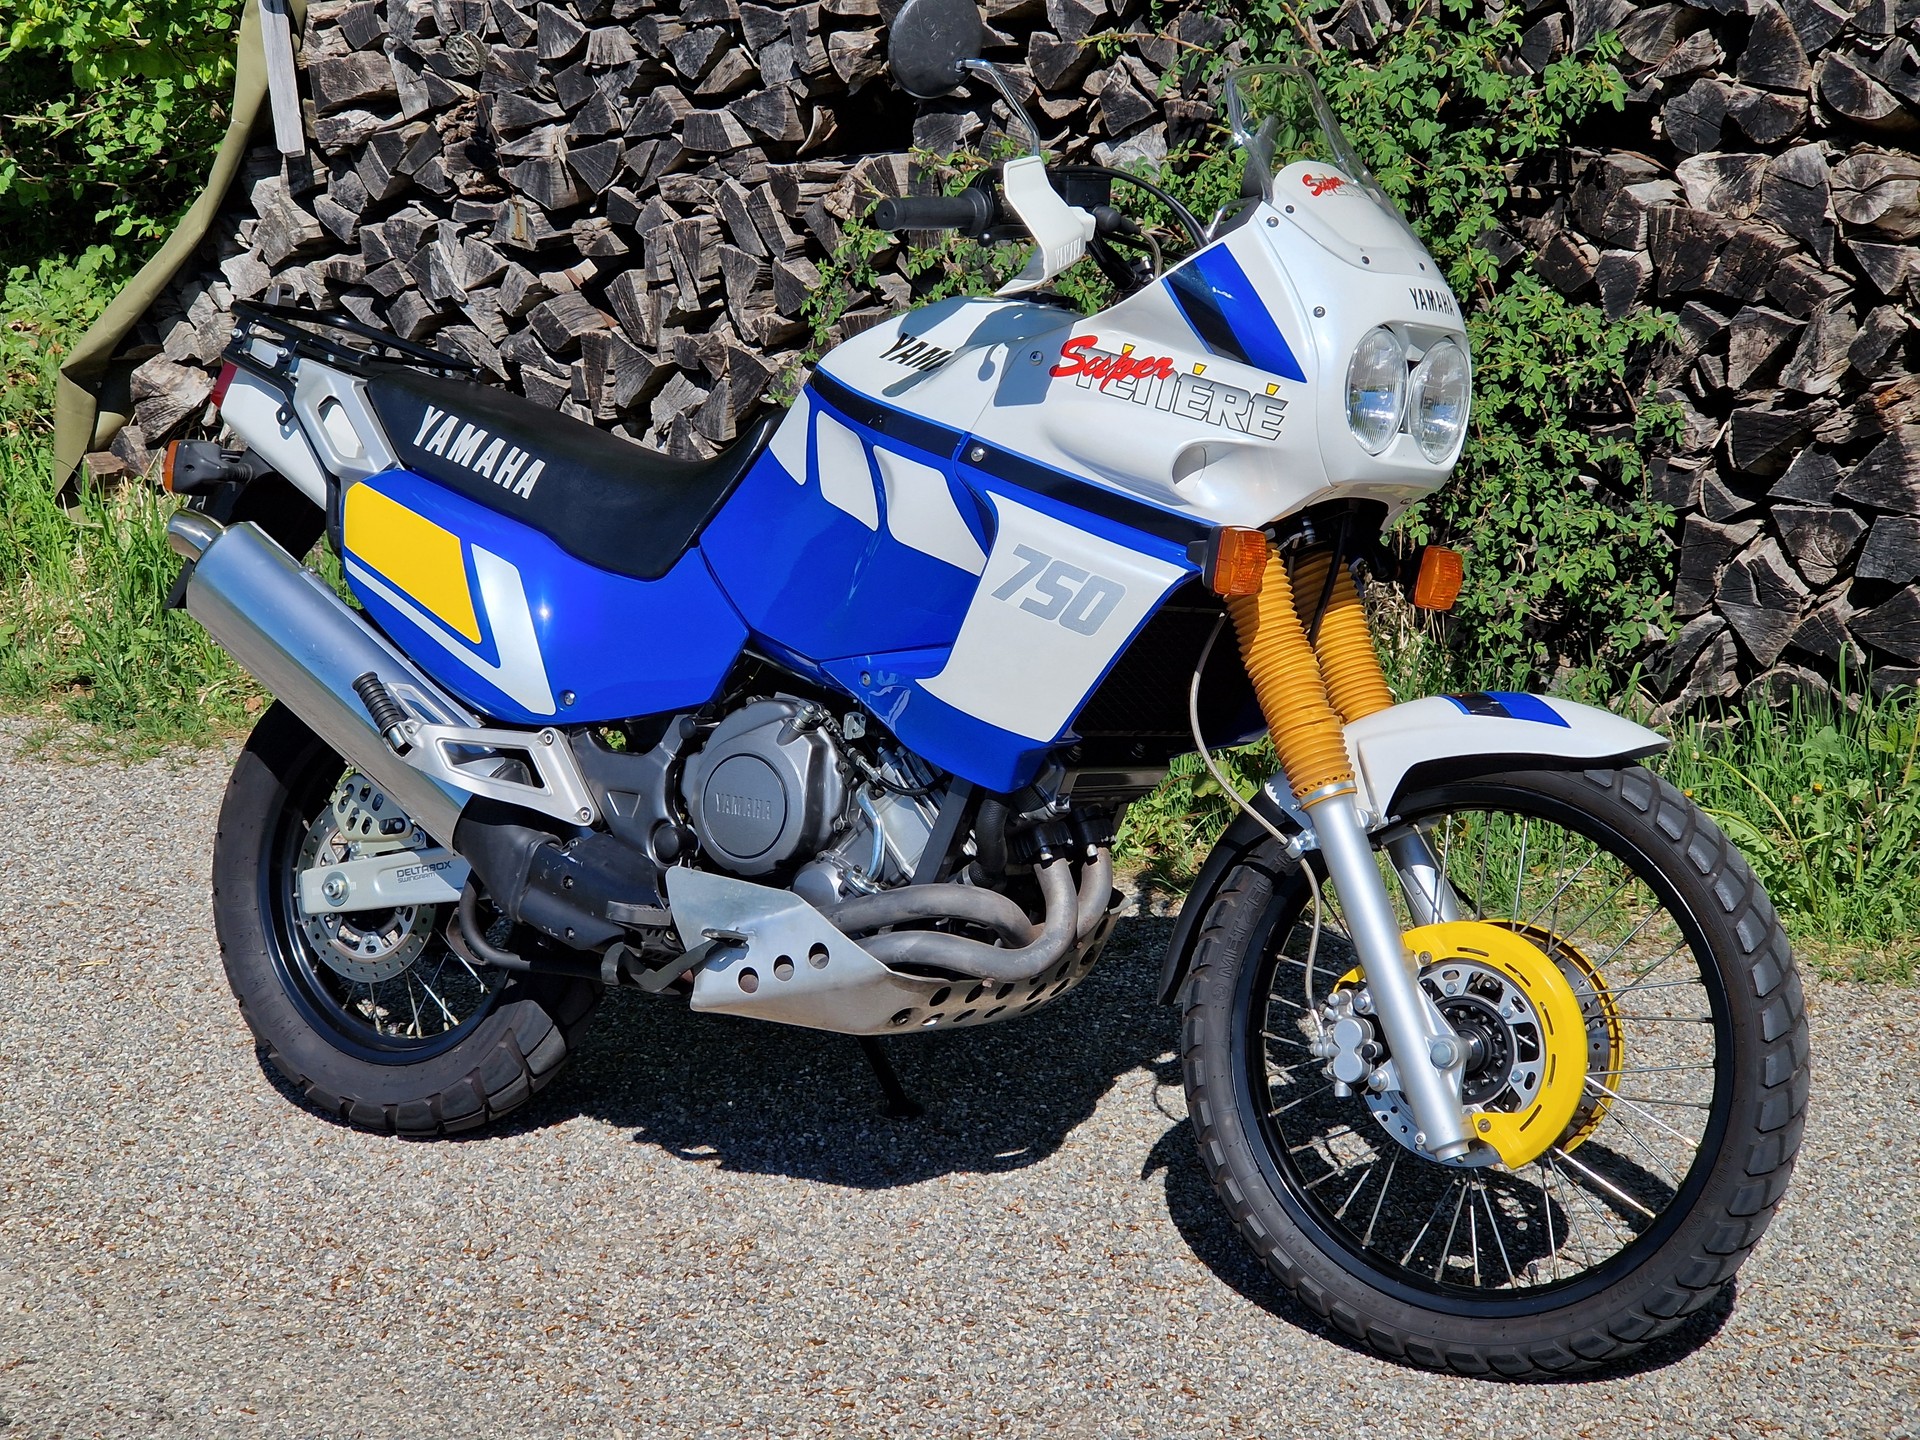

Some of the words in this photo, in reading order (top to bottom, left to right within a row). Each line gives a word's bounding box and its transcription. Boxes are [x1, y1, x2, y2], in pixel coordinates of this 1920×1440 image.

[1408, 287, 1455, 316] YAMAHA
[1049, 335, 1176, 391] Super
[412, 404, 546, 500] YAMAHA
[990, 543, 1127, 637] 750
[715, 792, 771, 820] YAMAHA
[396, 860, 452, 878] DELTABOX
